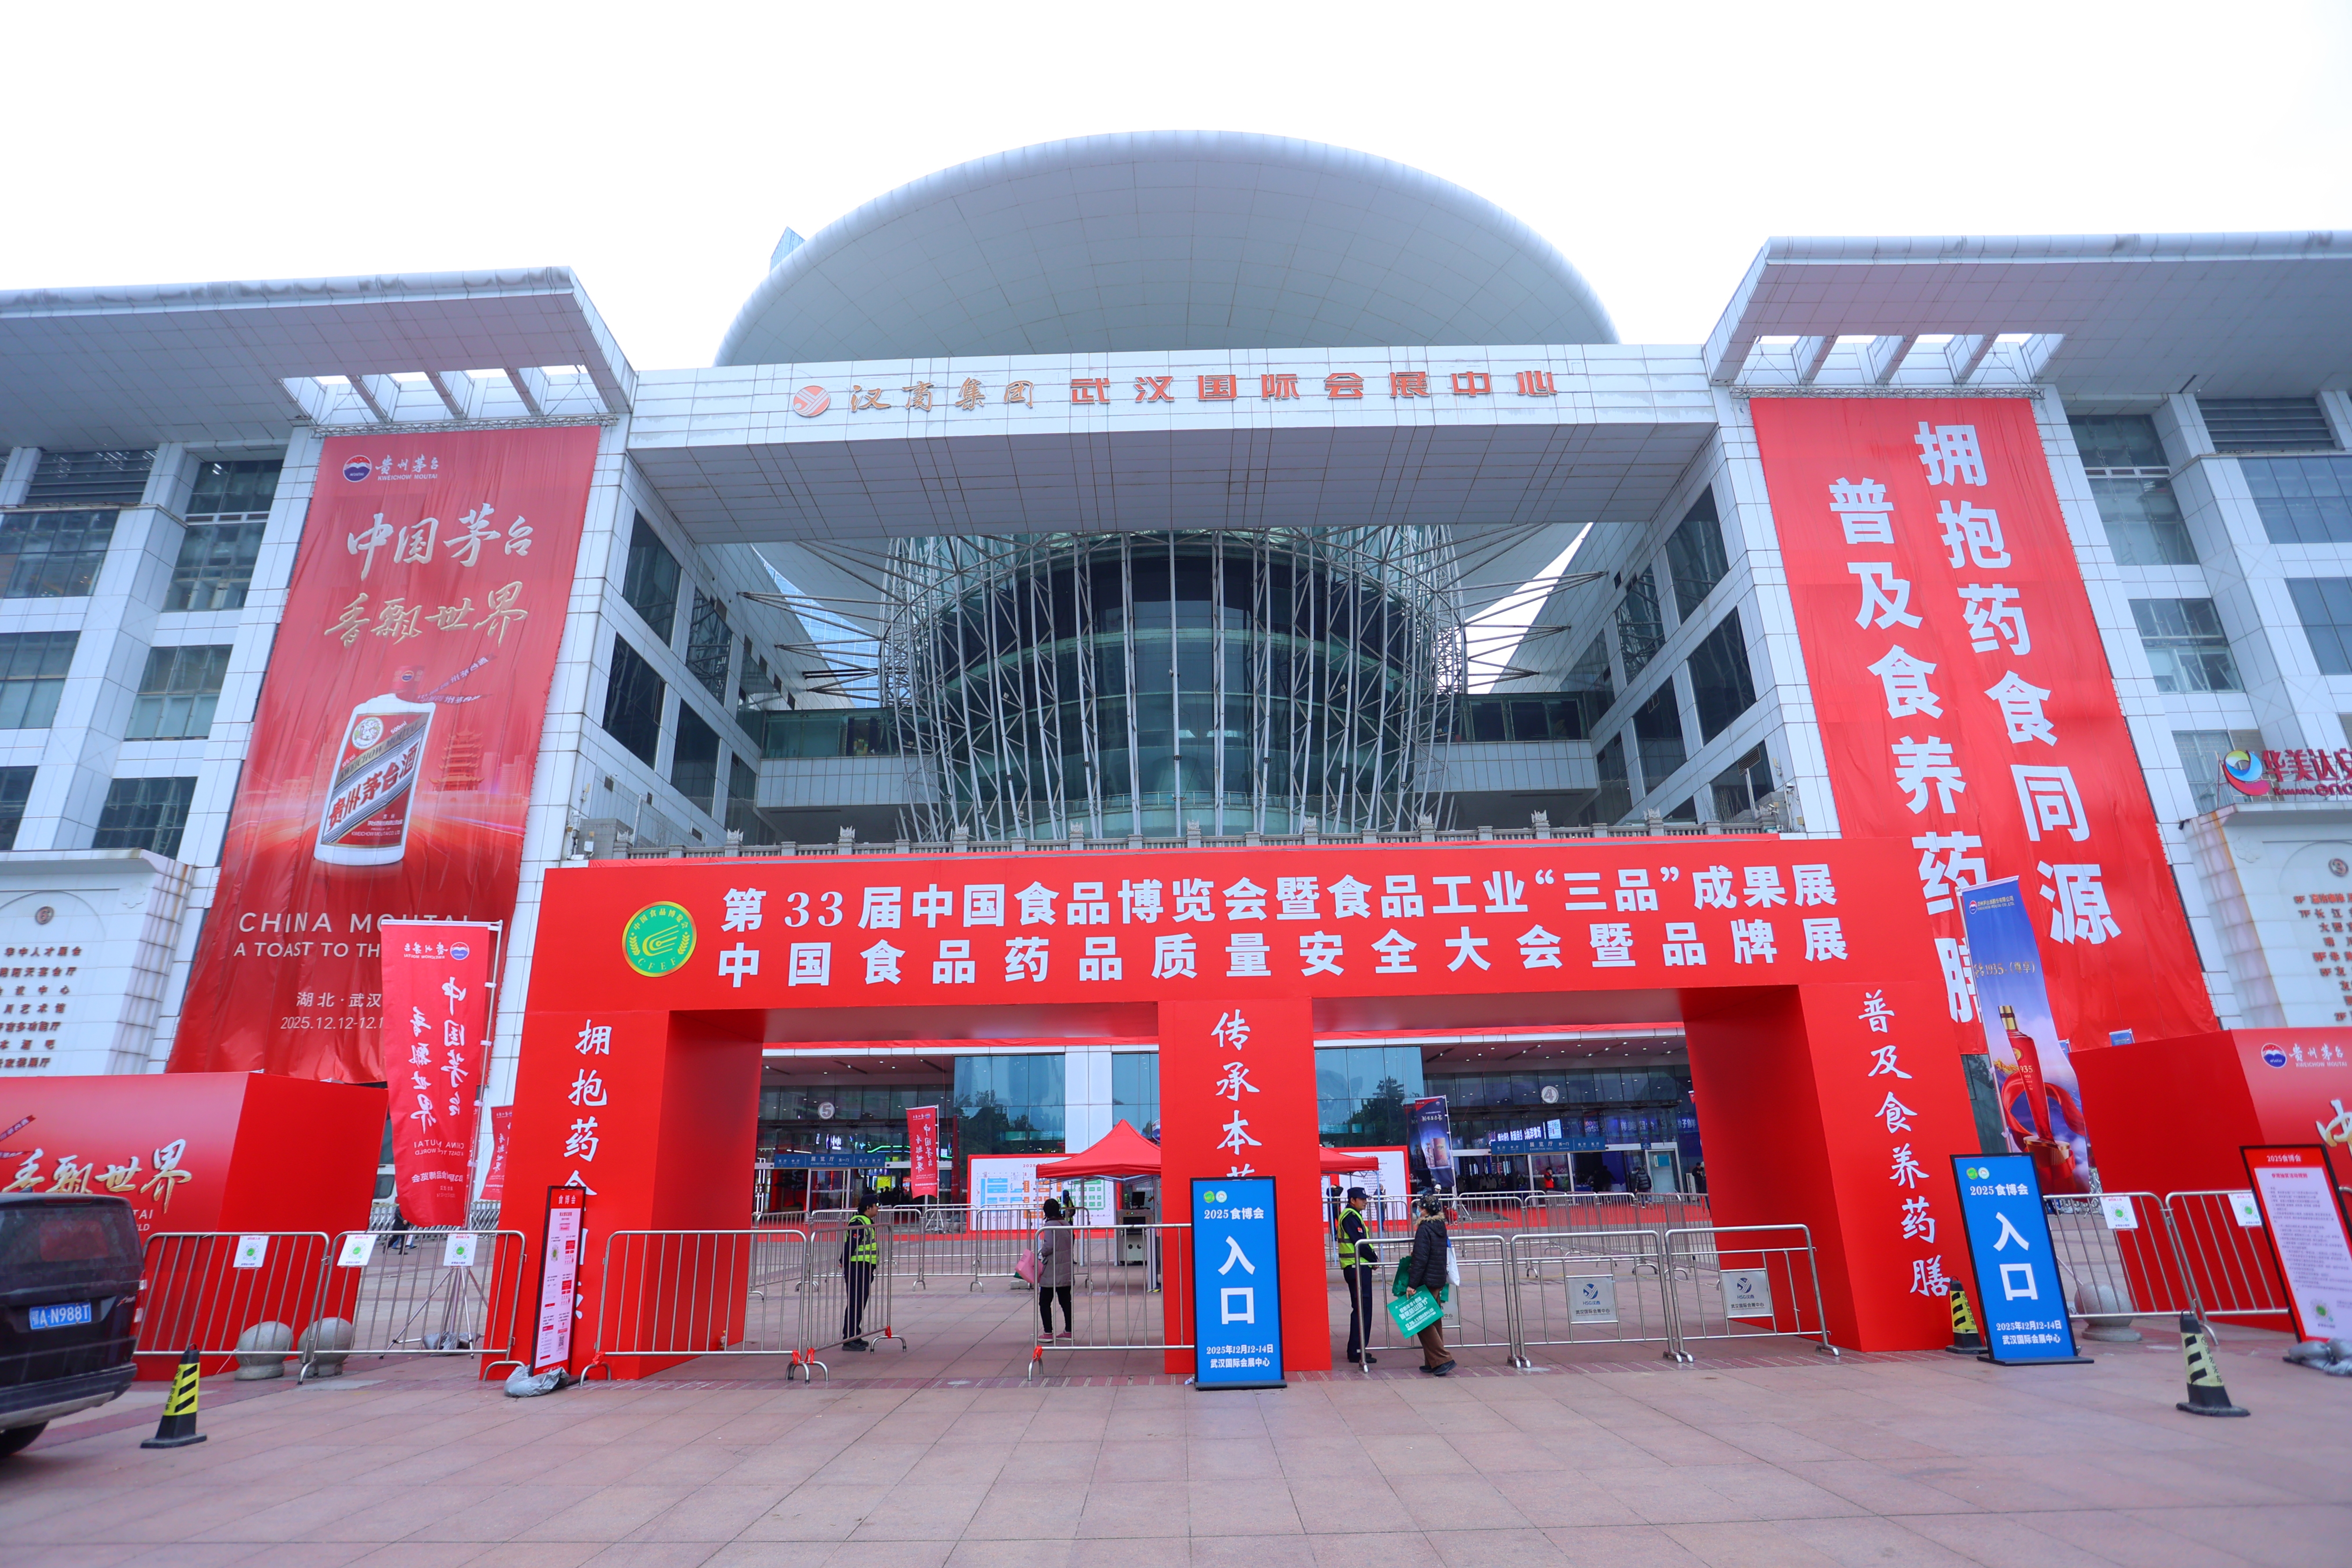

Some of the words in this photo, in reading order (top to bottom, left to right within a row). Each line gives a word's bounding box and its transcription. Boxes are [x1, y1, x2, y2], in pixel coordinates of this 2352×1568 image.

[848, 377, 1035, 414] 汉商集团
[1069, 371, 1558, 406] 武汉国际会展中心
[375, 454, 438, 474] 贵州茅台
[347, 503, 533, 581] 中国茅台
[324, 581, 528, 647] 香飘世界
[1914, 422, 2121, 945] 拥抱药食同源
[390, 721, 407, 734] 500ml
[326, 741, 421, 833] 贵州茅台酒
[721, 863, 1838, 932] 第33届中国食品博览会暨食品工业“三品”成果展
[239, 913, 332, 933] CHINA
[233, 942, 246, 957] A
[253, 942, 314, 957] TOAST
[321, 942, 349, 957] TO
[355, 943, 381, 958] TH
[718, 917, 1848, 988] 中国食品药品质量安全大会暨品牌展
[638, 958, 676, 970] CFEF
[296, 992, 381, 1007] 湖北·武汉
[280, 1017, 383, 1029] 2025.12.12-12.1
[2289, 1043, 2344, 1061] 贵州茅台
[1858, 989, 1950, 1297] 普及食养药膳
[1970, 1183, 2029, 1196] 2025食博会
[558, 1195, 576, 1204] 食博会
[132, 1209, 154, 1220] TAI
[1204, 1207, 1264, 1220] 2025食博会
[1993, 1211, 2038, 1301] 入口
[1218, 1235, 1256, 1325] 入口
[1997, 1320, 2063, 1332] 2025年12月12-14日
[2002, 1334, 2061, 1345] 武汉国际会展中心
[1206, 1343, 1274, 1355] 2025年12月12-14日
[1210, 1357, 1270, 1369] 武汉国际会展中心
